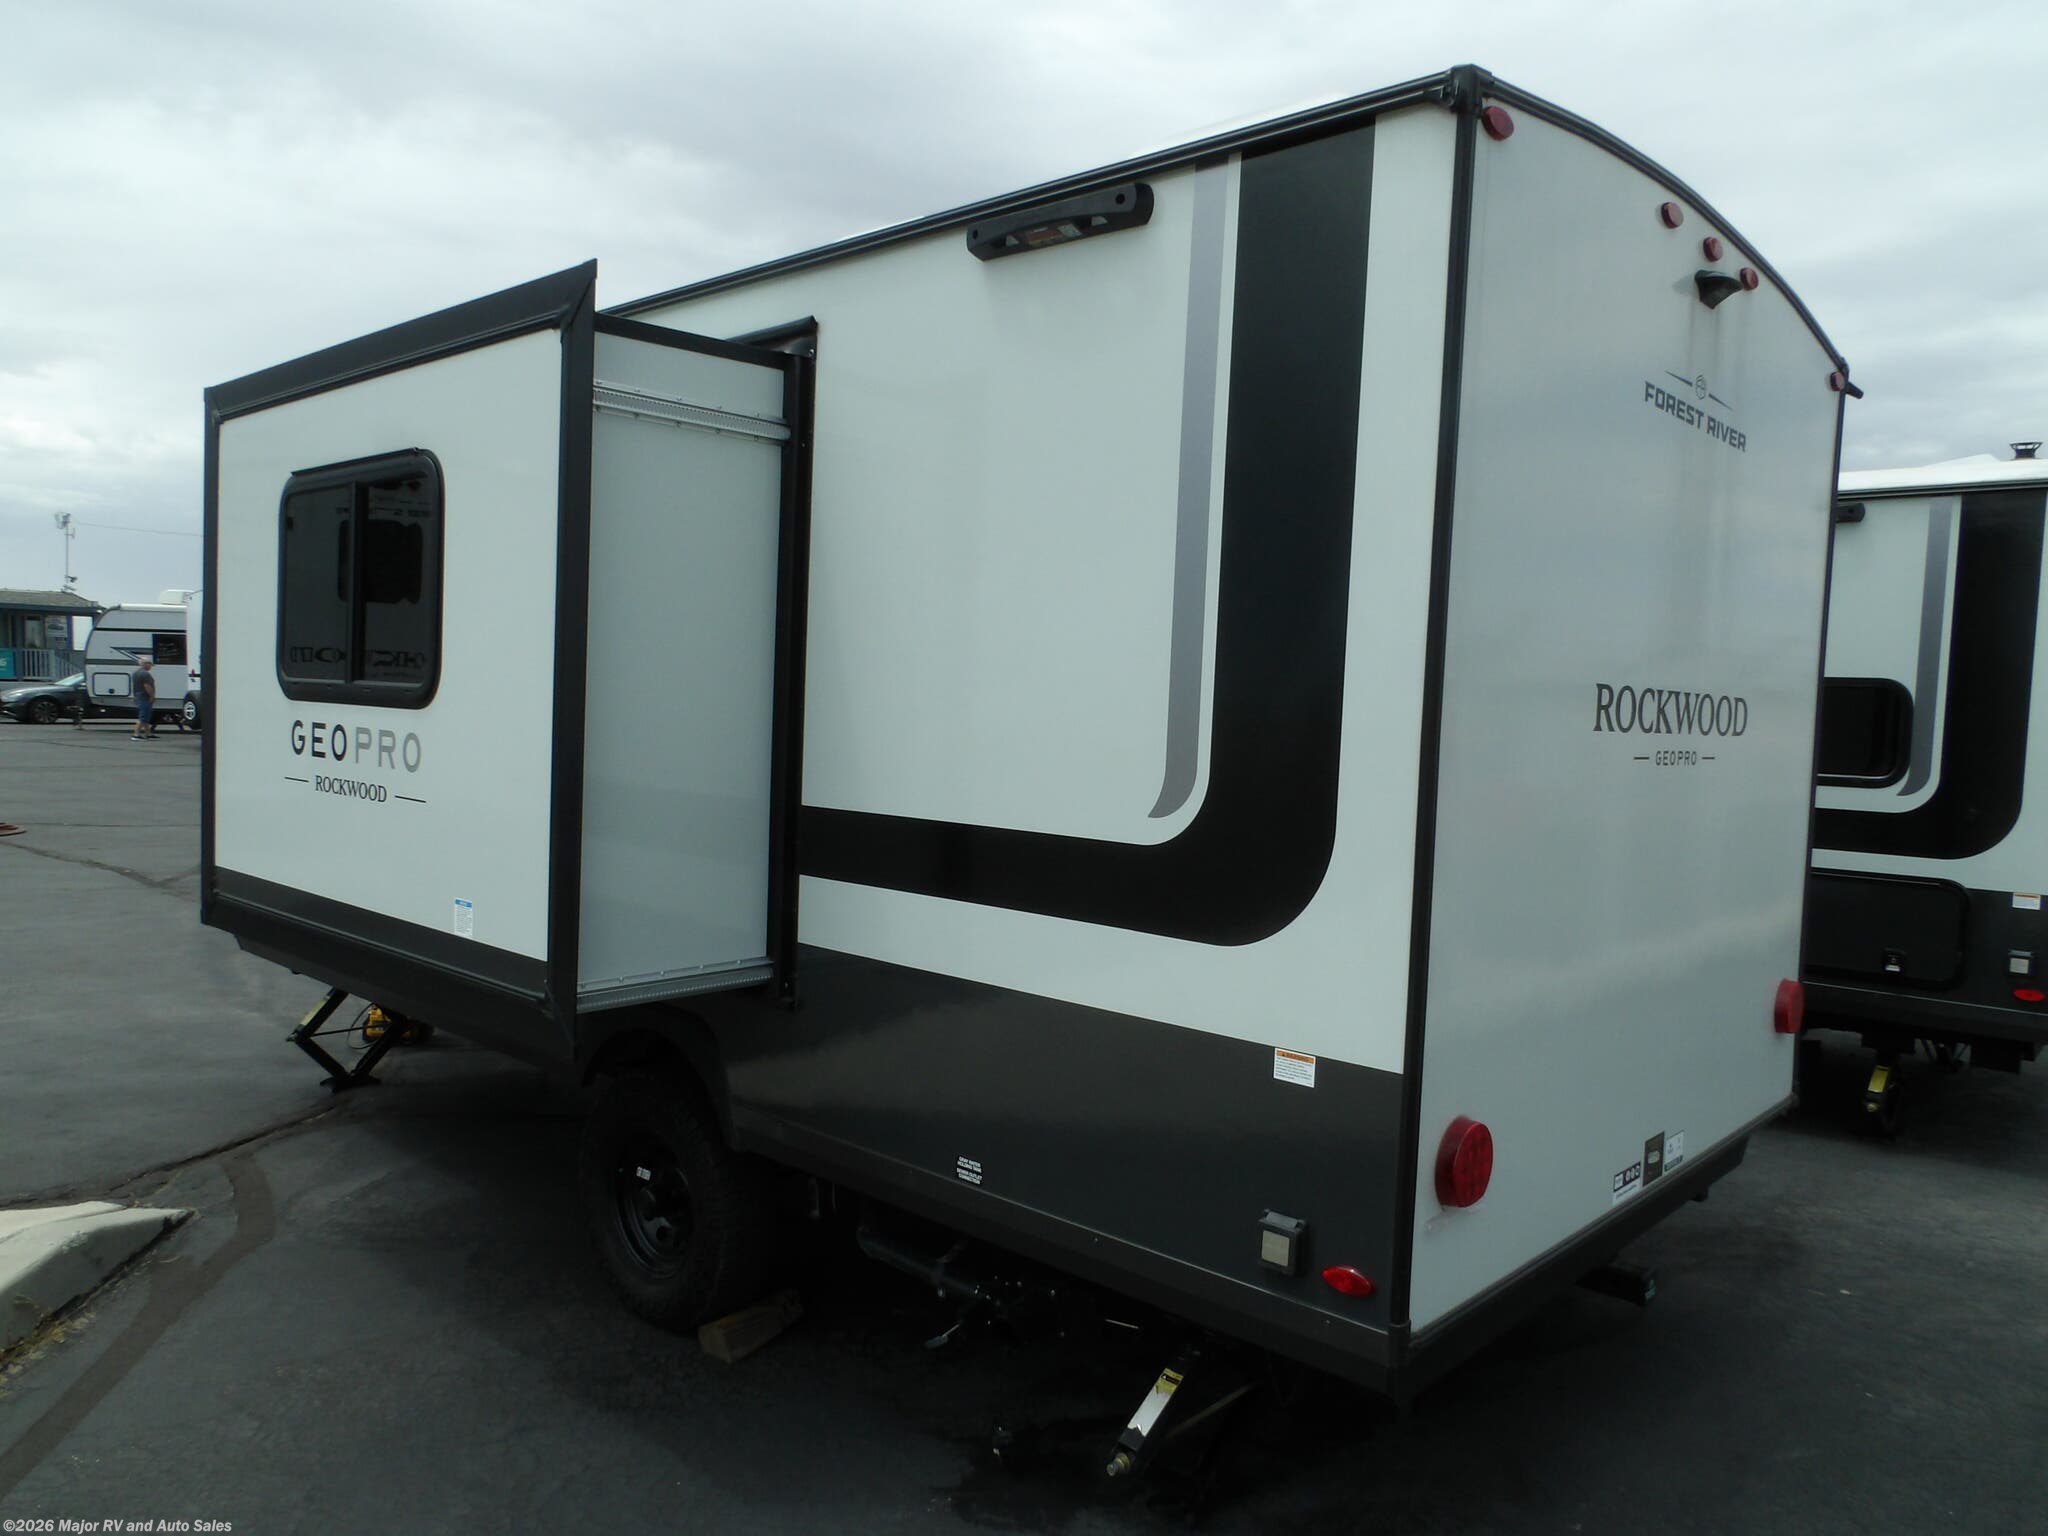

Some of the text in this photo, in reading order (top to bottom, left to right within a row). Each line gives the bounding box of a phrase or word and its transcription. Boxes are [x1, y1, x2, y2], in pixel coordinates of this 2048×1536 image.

[1644, 380, 1746, 452] FOREST RIVER
[1592, 682, 1748, 736] ROCKWOOD
[291, 719, 422, 773] GEOPRO
[1655, 750, 1698, 766] GEOPRO
[315, 774, 387, 803] ROCKWOOD
